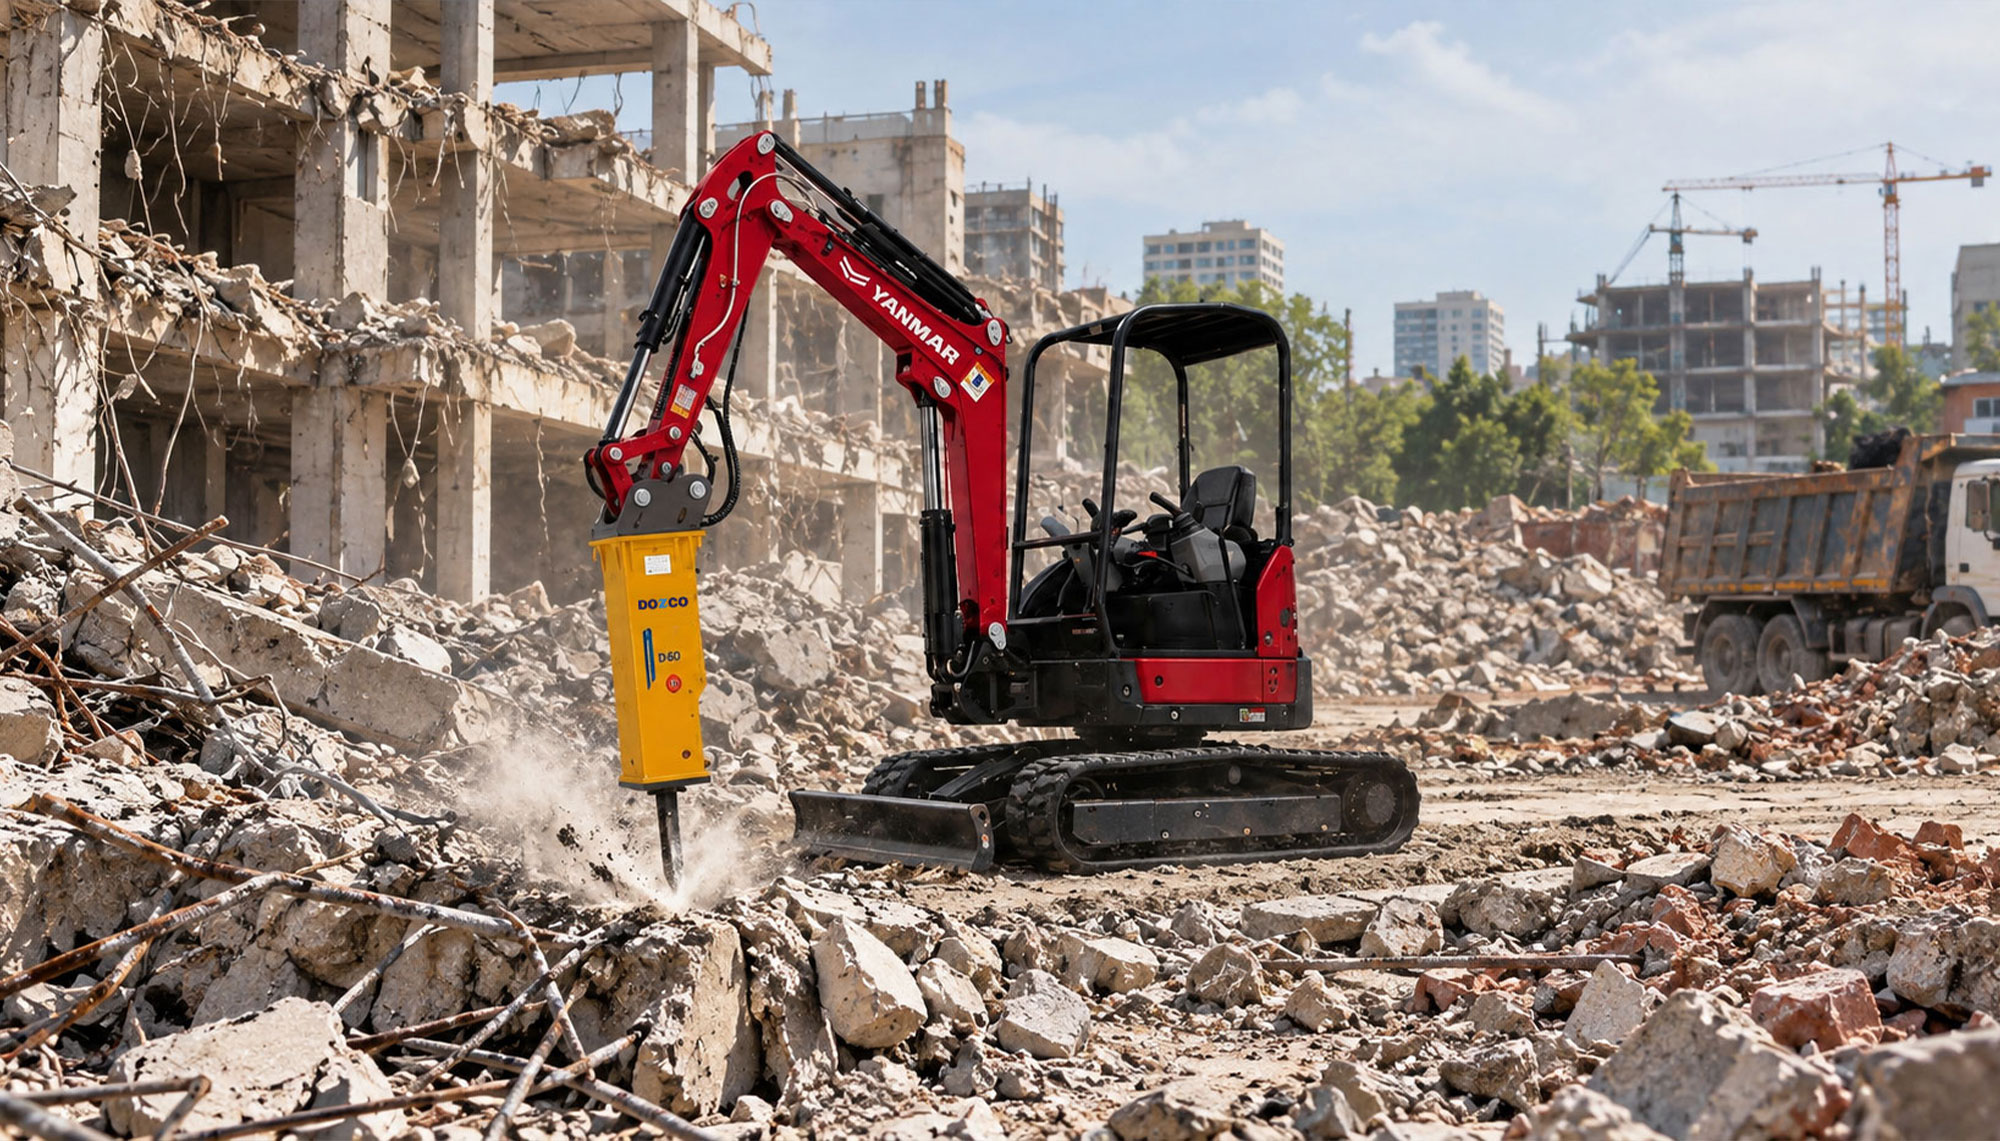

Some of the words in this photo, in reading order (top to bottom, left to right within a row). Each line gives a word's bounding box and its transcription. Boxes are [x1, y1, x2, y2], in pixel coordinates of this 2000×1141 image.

[872, 284, 960, 365] YANMAR
[638, 596, 688, 610] DOZCO
[658, 651, 681, 663] D60
